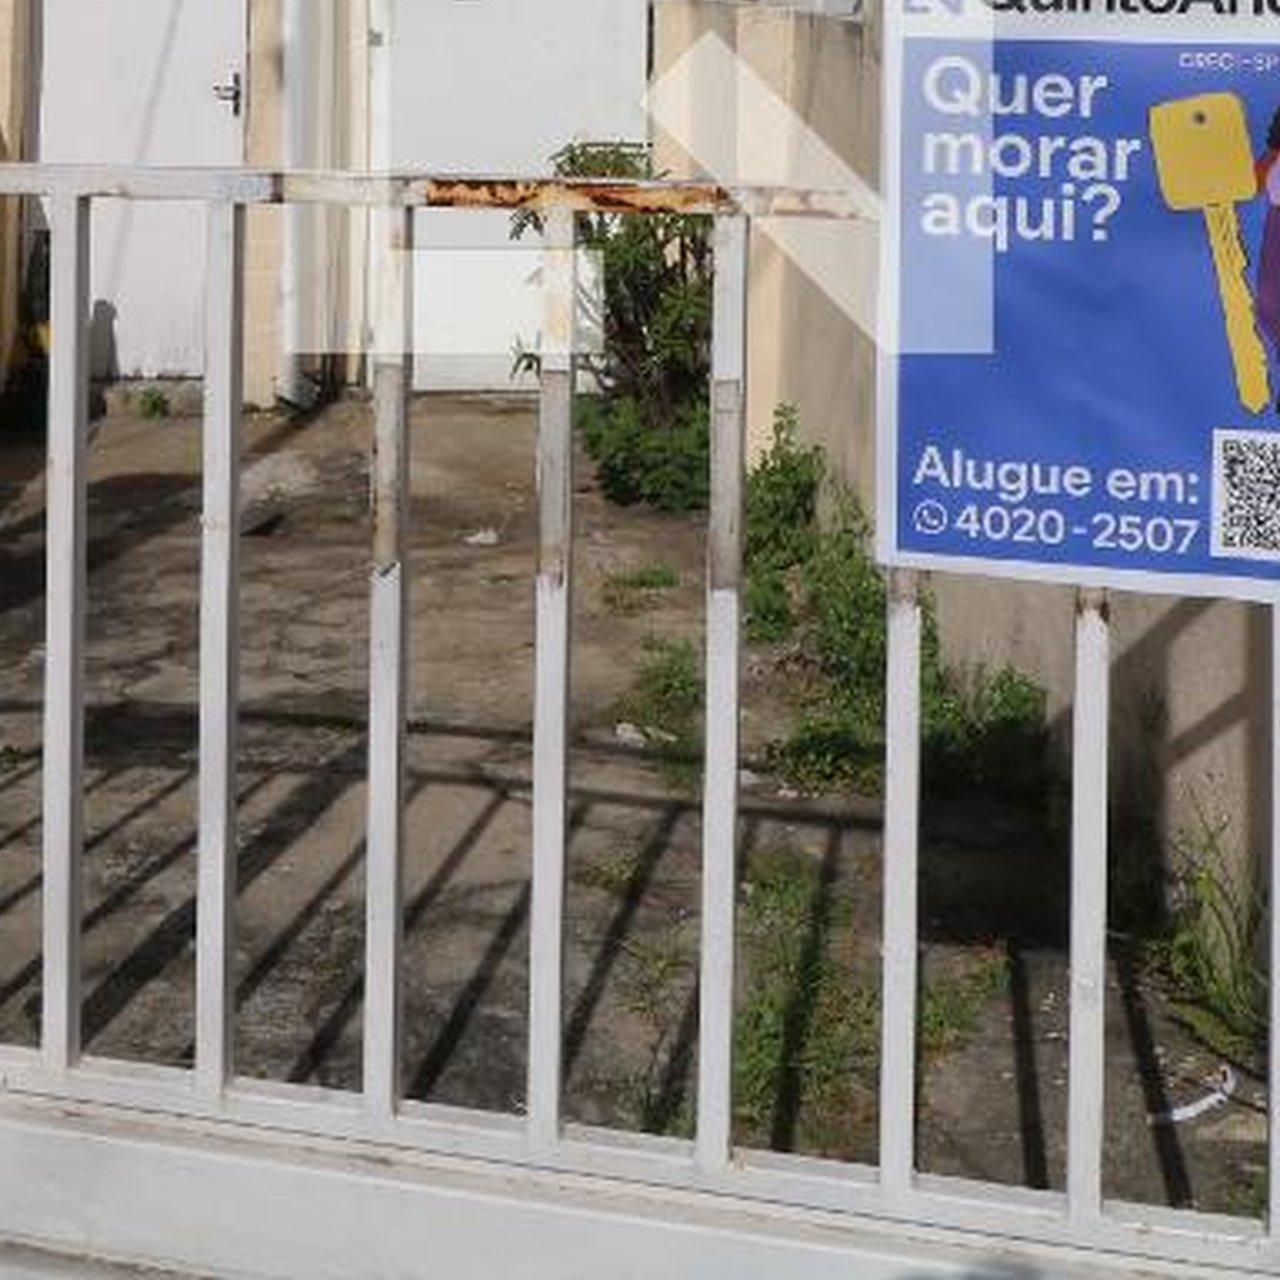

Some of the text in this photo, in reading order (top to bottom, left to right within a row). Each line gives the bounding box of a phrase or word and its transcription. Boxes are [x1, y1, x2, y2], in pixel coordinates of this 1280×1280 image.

[923, 55, 1109, 118] Quer
[923, 131, 1141, 181] morar
[921, 183, 1121, 251] aqui?
[913, 445, 1199, 504] Alugue em:
